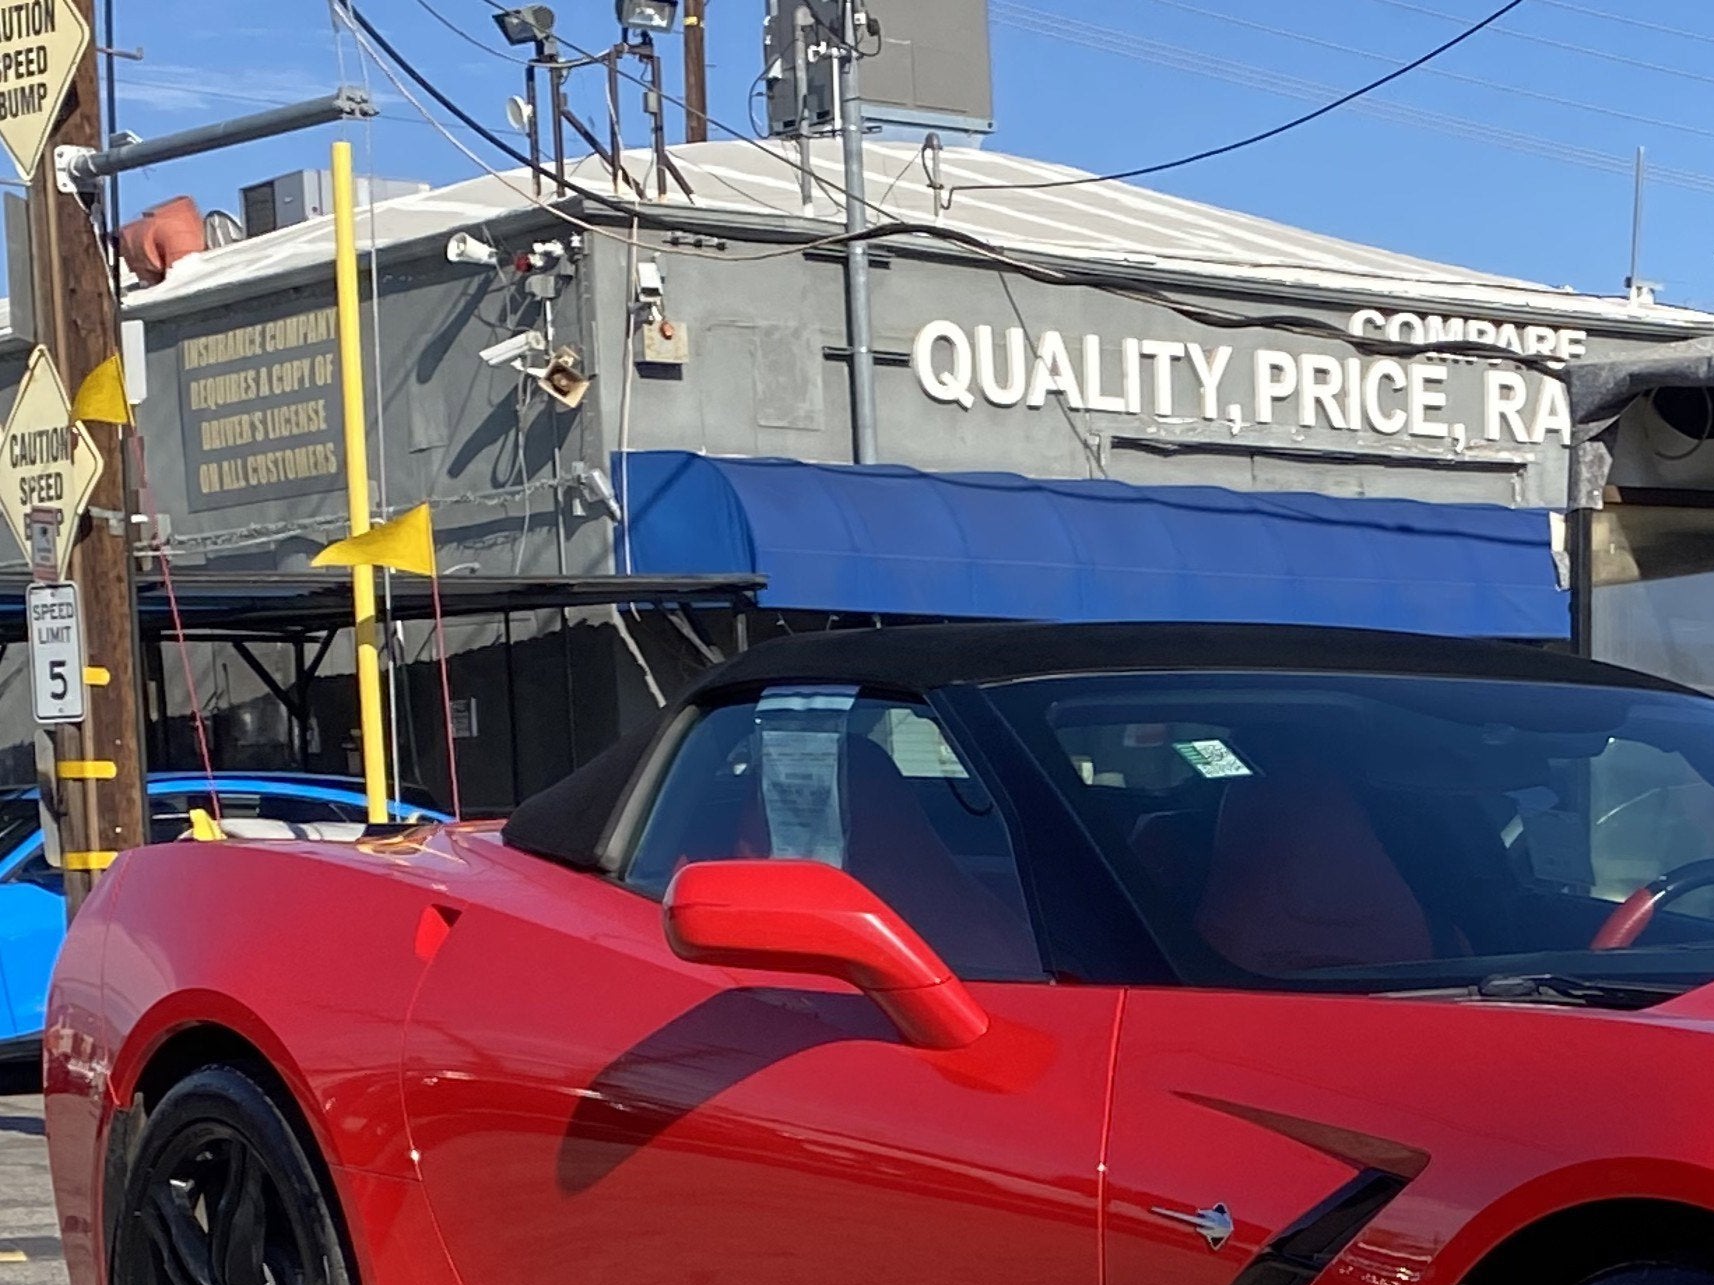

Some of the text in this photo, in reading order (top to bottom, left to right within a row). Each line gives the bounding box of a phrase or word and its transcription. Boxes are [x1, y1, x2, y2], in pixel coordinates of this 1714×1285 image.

[0, 0, 55, 43] UTION
[0, 45, 48, 83] PEED
[184, 306, 338, 371] INSURANCE COMPANY
[1348, 308, 1587, 369] COMPARE
[190, 353, 334, 411] REQUIRES A COPY OF
[912, 319, 1244, 437] QUALITY,
[1254, 349, 1467, 453] PRICE,
[202, 399, 328, 451] DRIVER'S LICENSE
[10, 427, 71, 469] CAUTION
[221, 457, 247, 490] ALL
[247, 441, 338, 487] CUSTOMERS
[19, 472, 63, 506] SPEED
[33, 602, 74, 621] SPEED
[38, 625, 71, 645] LIMIT
[49, 660, 67, 700] 5
